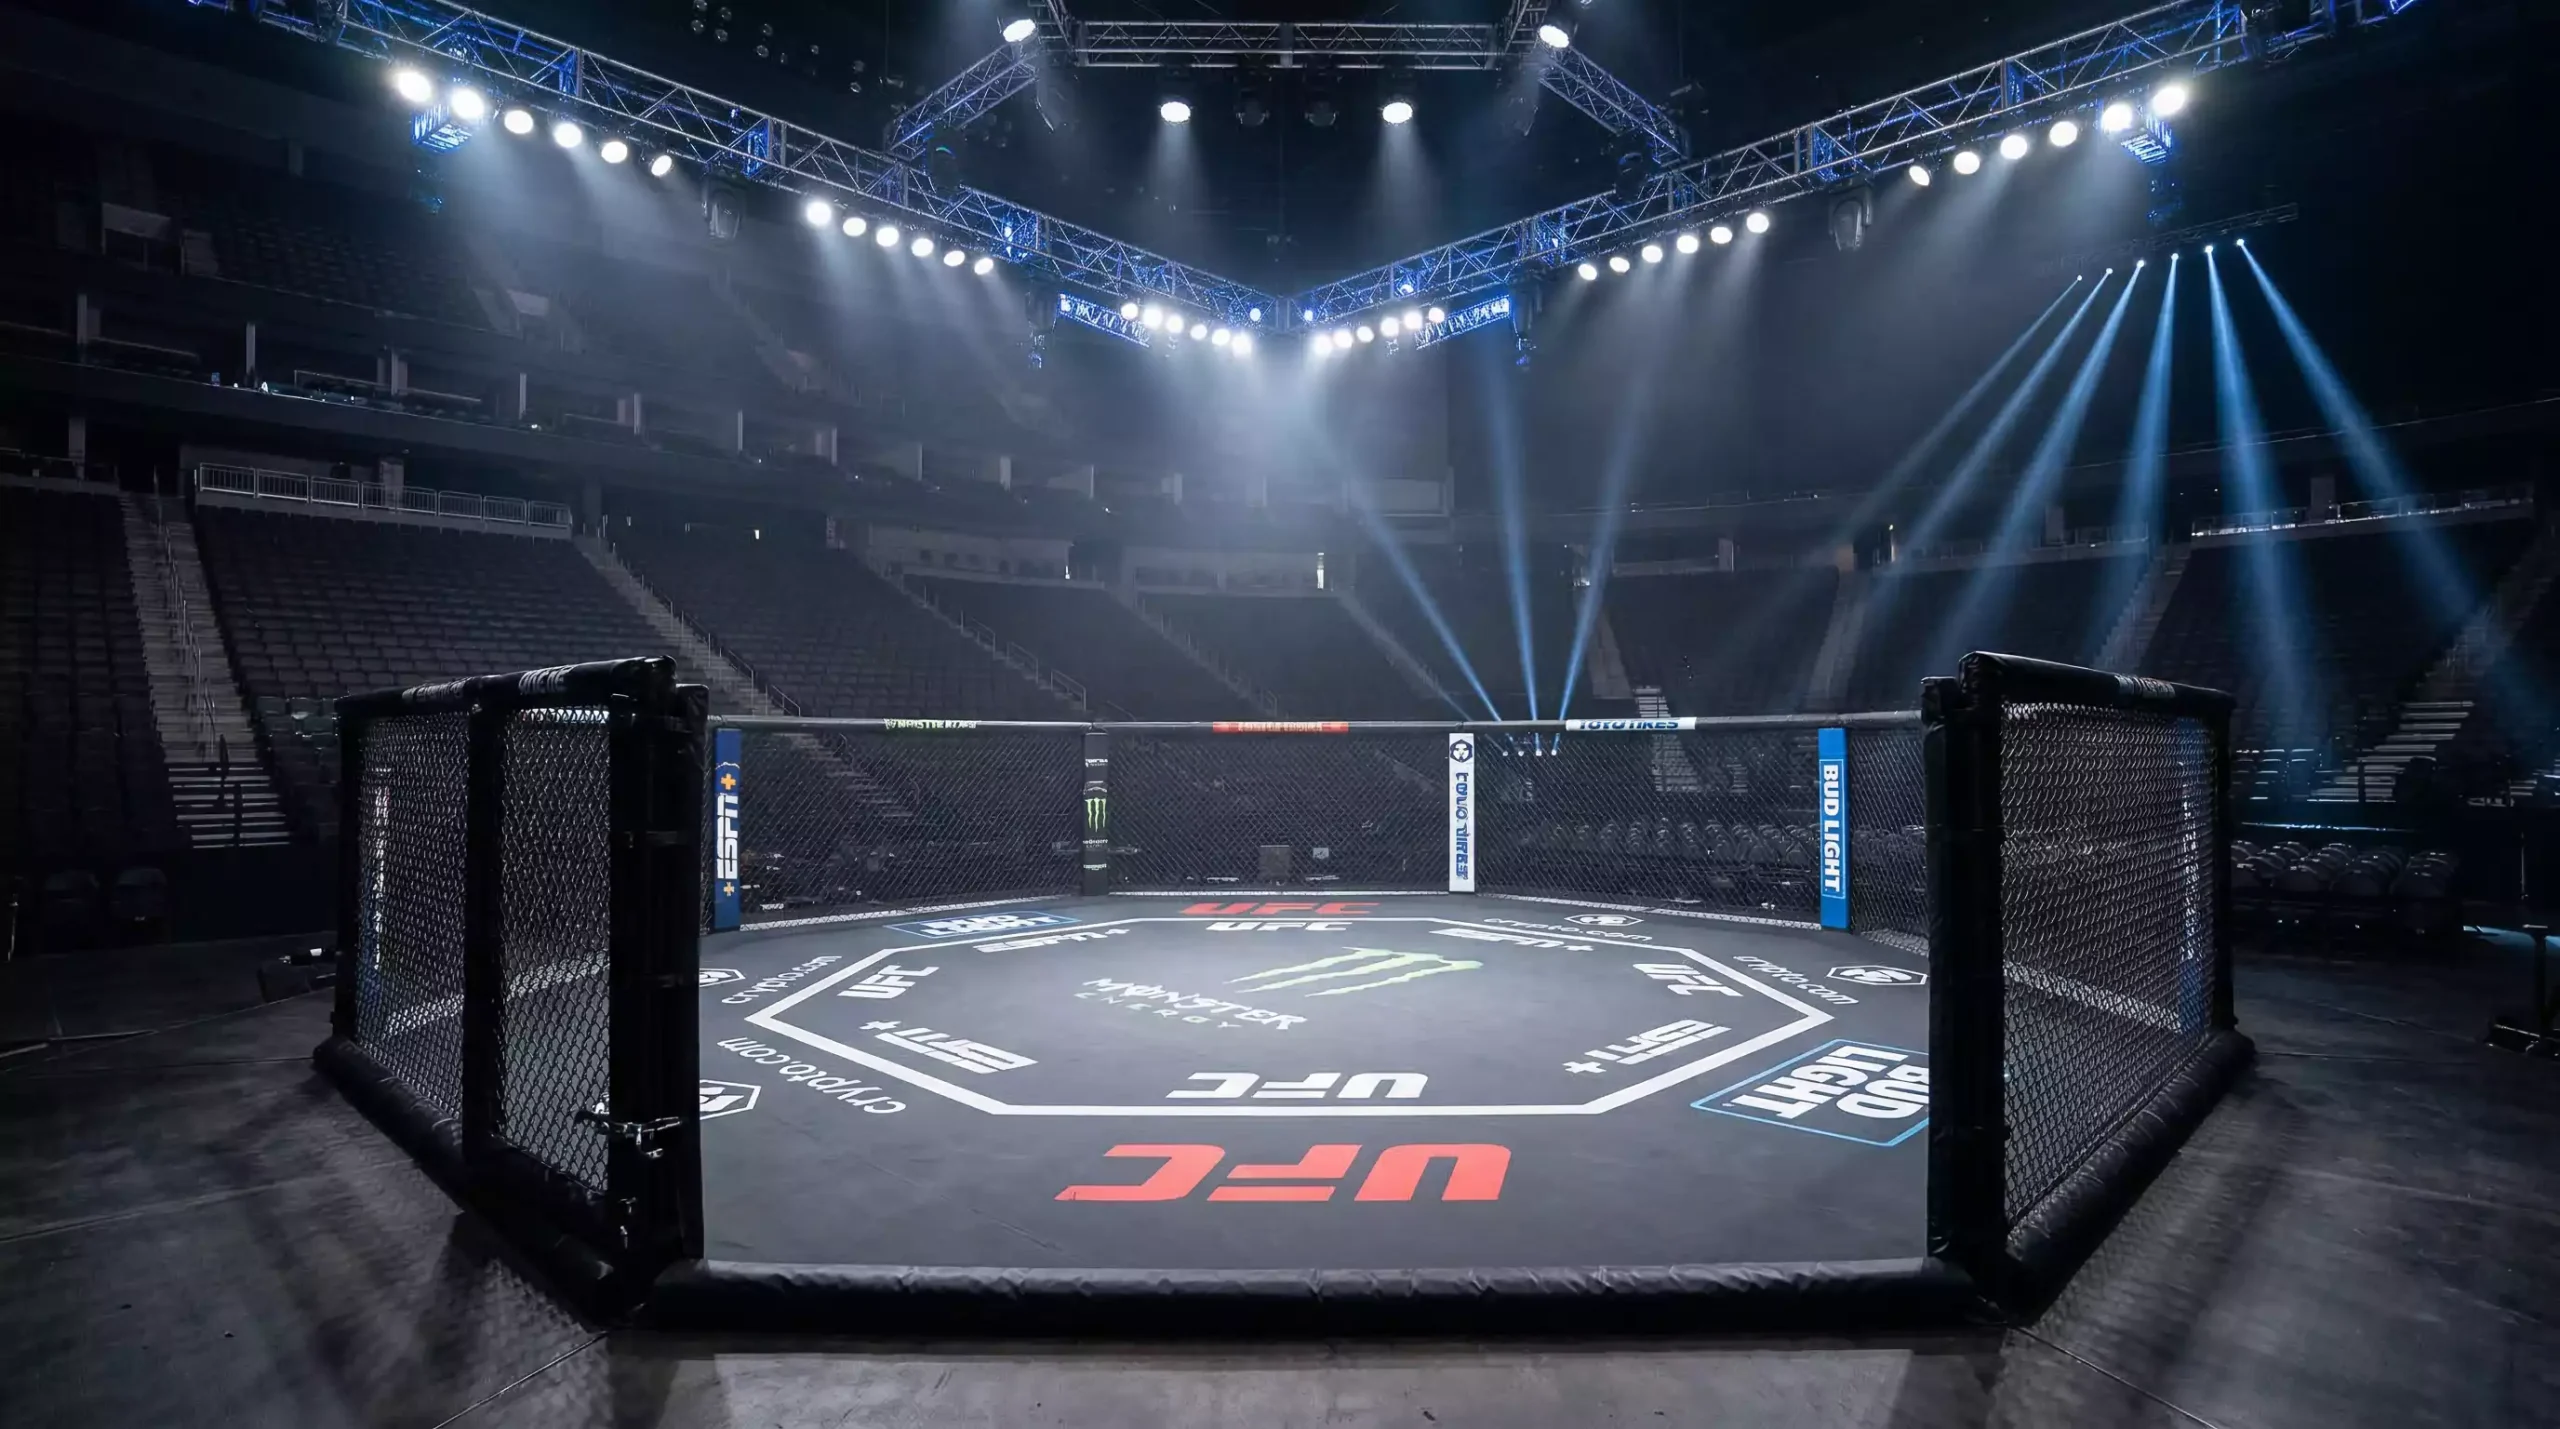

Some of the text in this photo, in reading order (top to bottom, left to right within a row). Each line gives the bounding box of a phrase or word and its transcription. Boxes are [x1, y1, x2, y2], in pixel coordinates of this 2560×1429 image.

[1823, 764, 1841, 892] BUD LIGHT
[1179, 902, 1380, 915] UFC
[1205, 921, 1353, 931] UFC
[837, 964, 940, 999] UFC
[1082, 978, 1308, 1030] MONSTER
[716, 1037, 907, 1115] crypto.com
[1165, 1072, 1428, 1098] UFC
[1730, 1045, 1909, 1120] LIGHT
[1053, 1143, 1512, 1202] UFC
